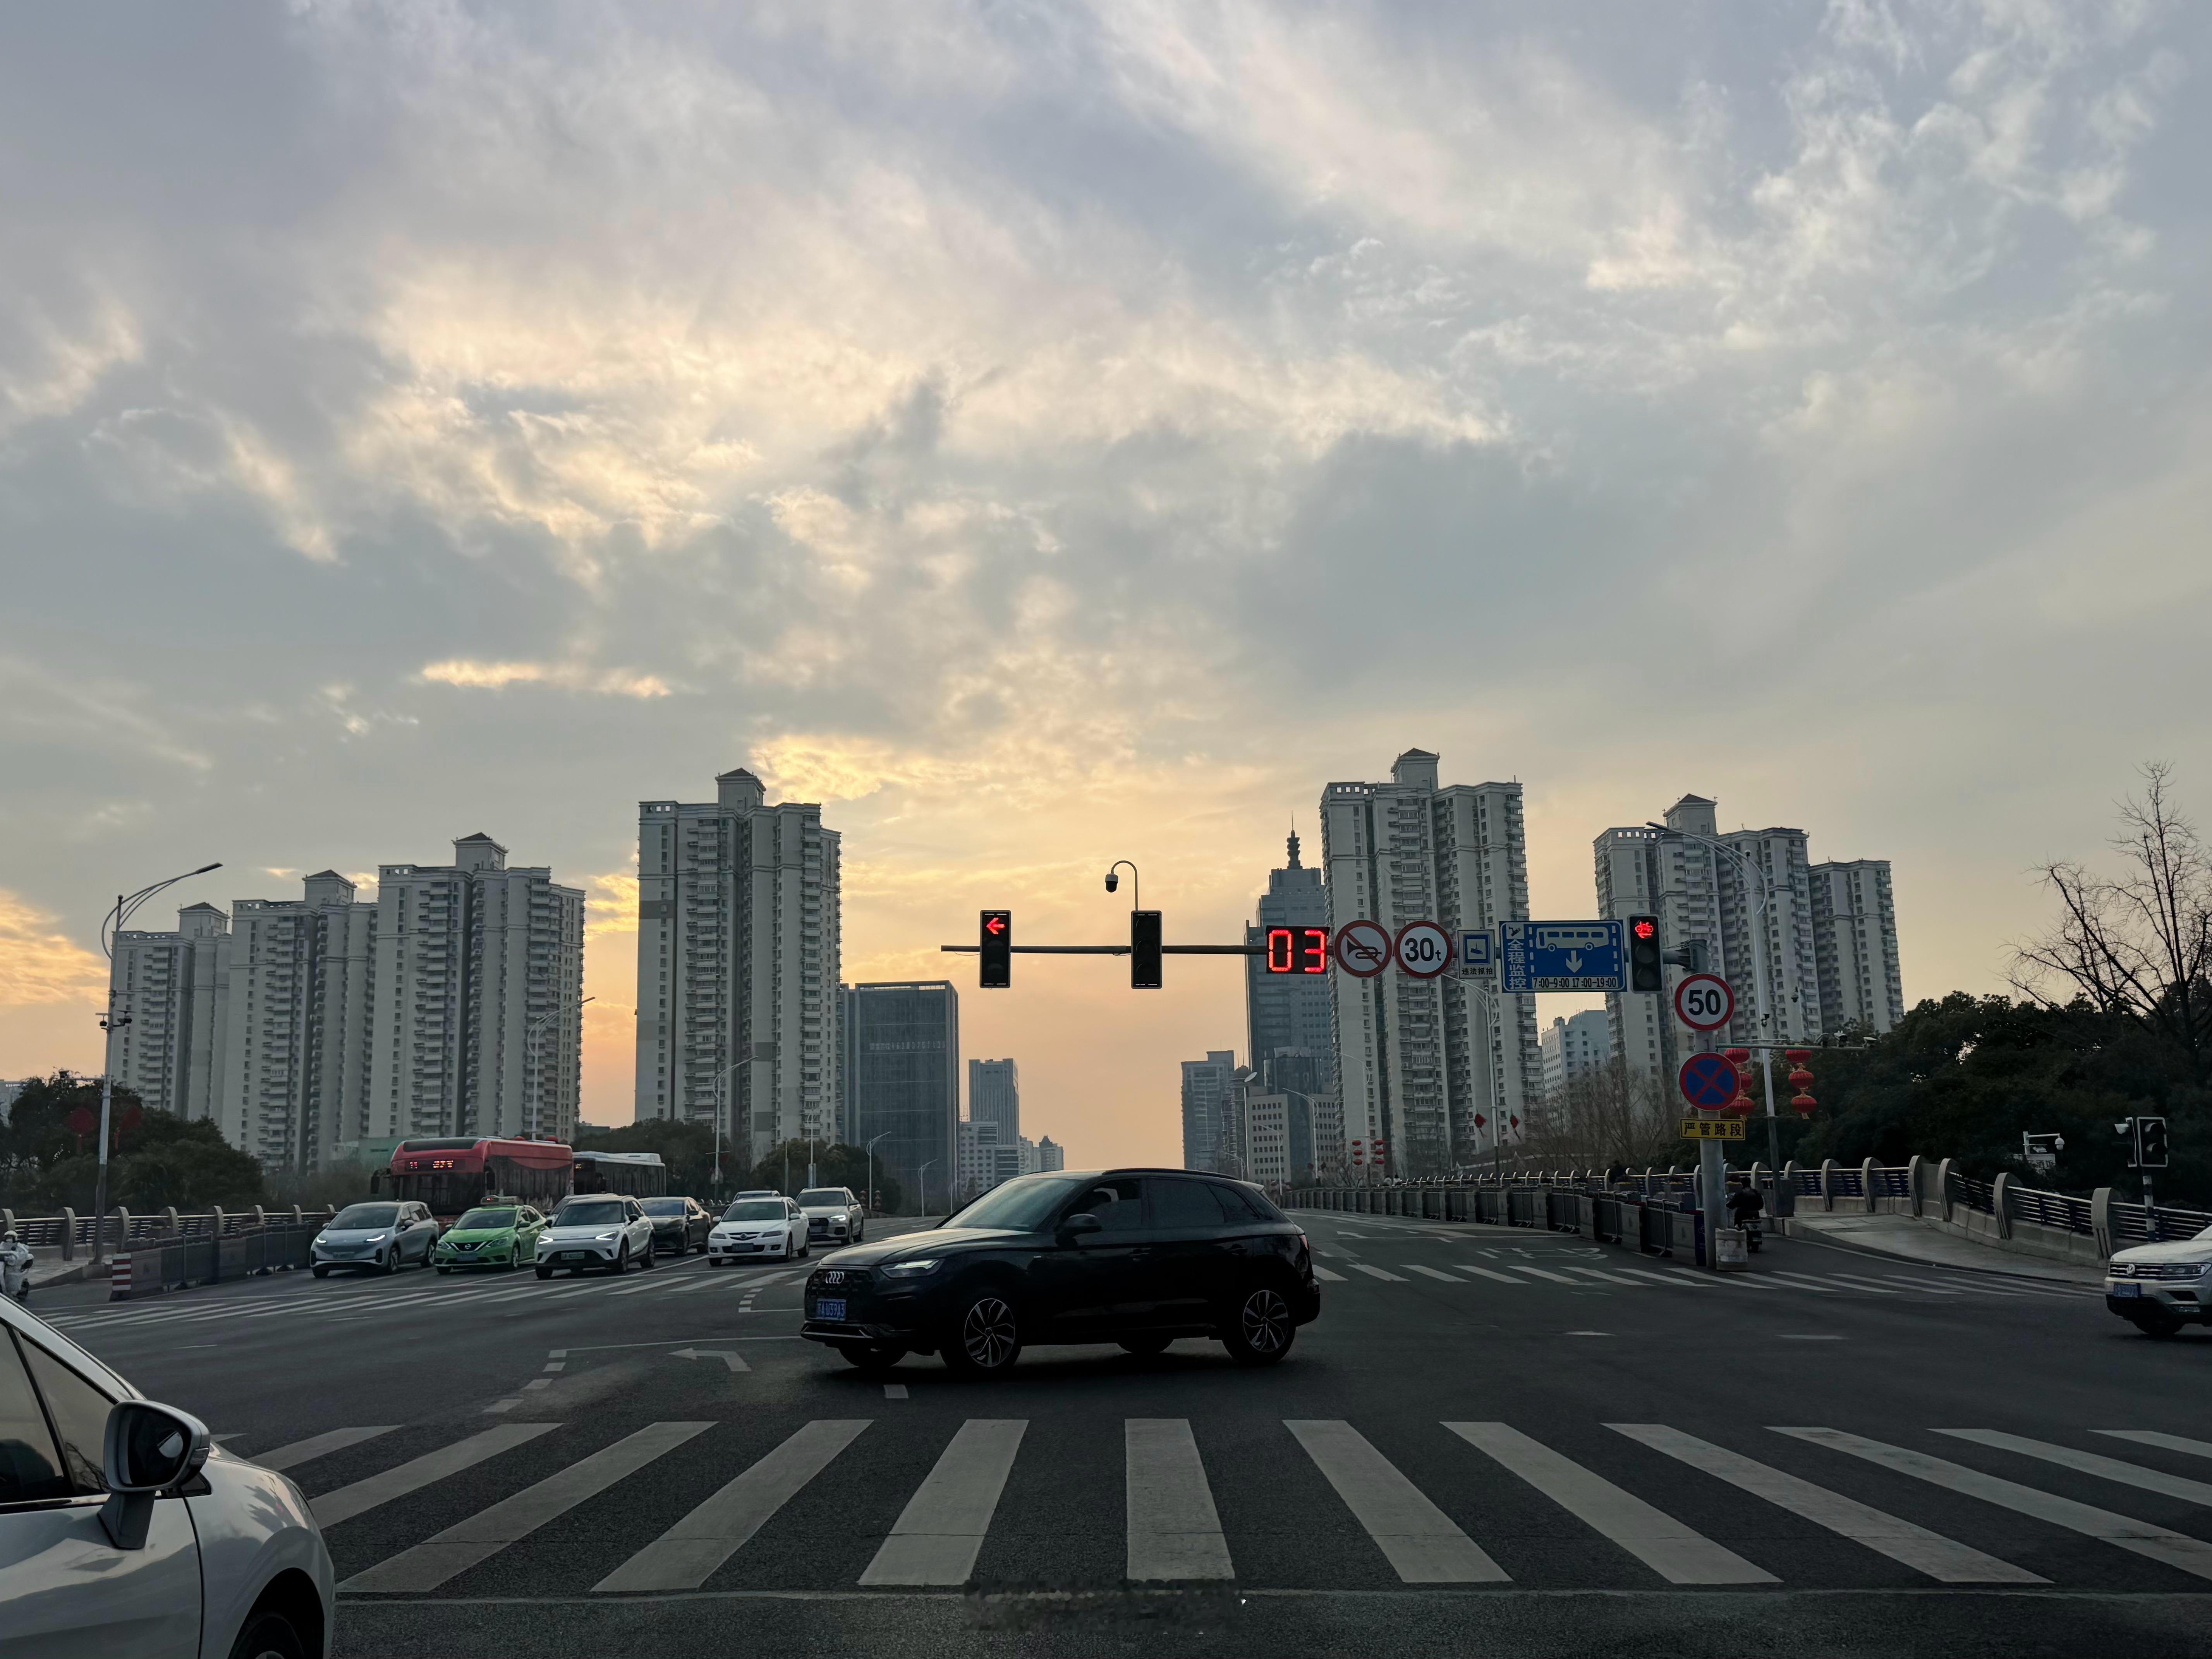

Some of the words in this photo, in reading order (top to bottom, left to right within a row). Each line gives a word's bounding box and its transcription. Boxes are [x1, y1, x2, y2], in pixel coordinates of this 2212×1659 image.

[1268, 930, 1326, 972] 03
[1508, 939, 1526, 989] 全程监控
[1688, 989, 1721, 1015] 50
[1684, 1122, 1742, 1136] 严管路段
